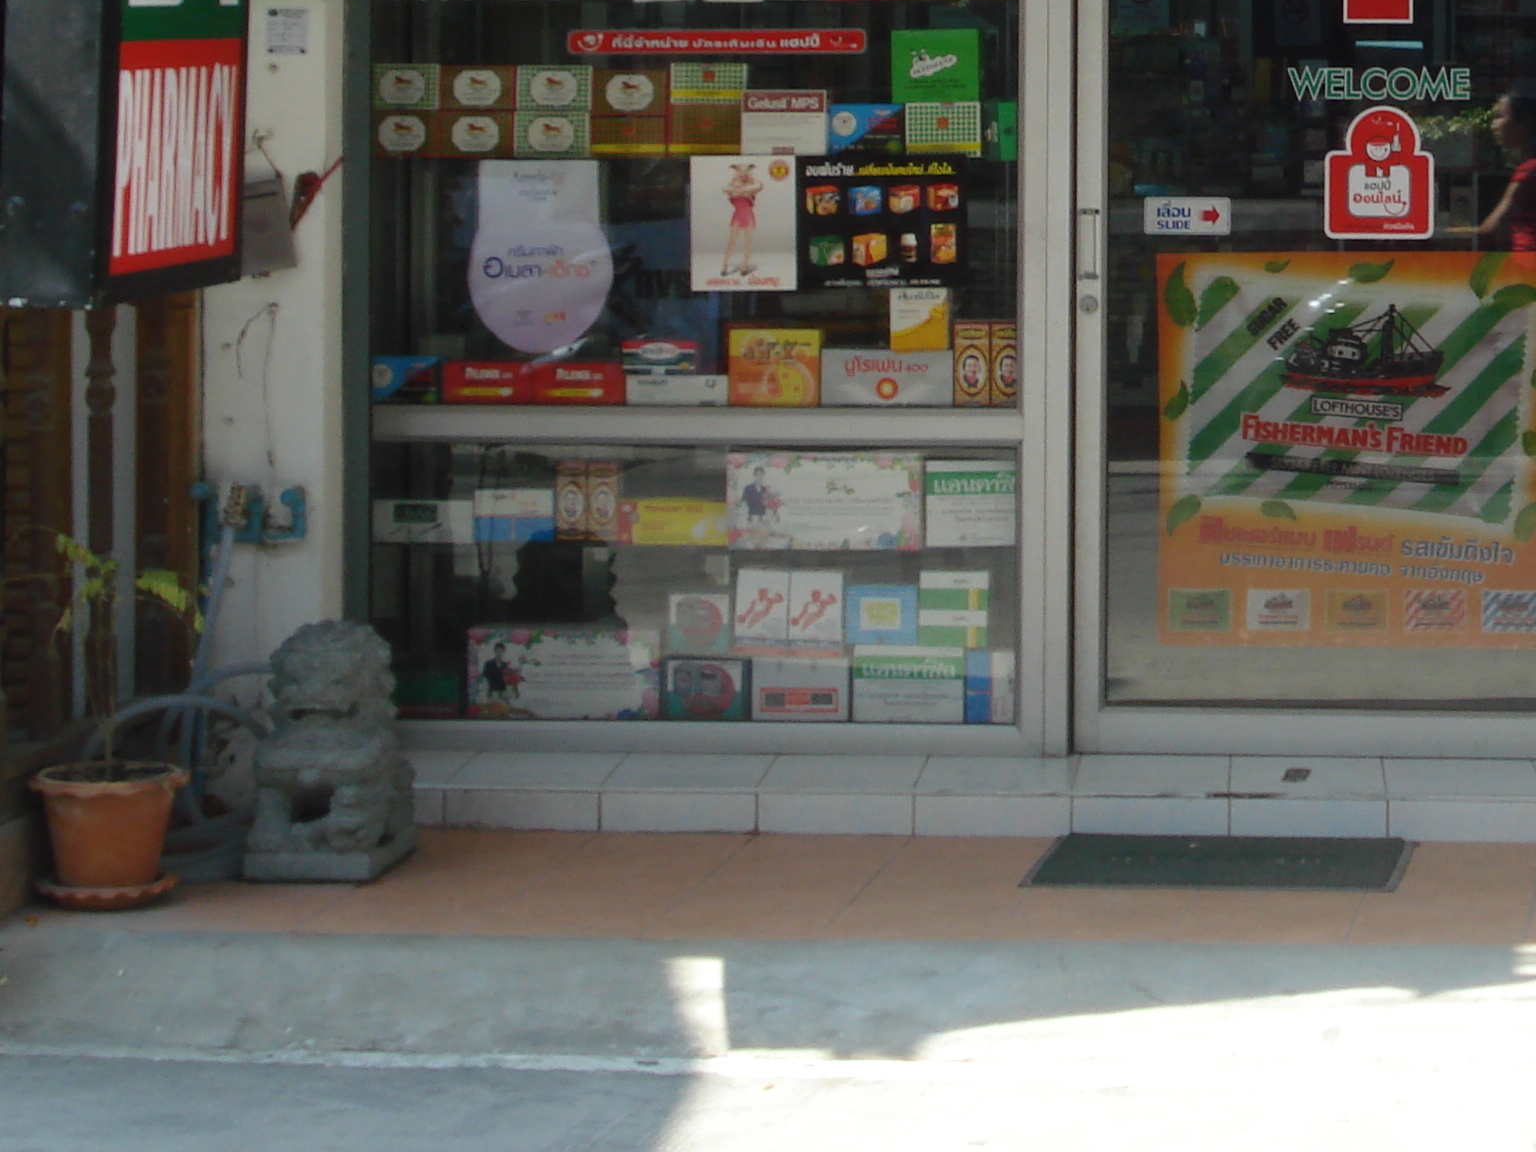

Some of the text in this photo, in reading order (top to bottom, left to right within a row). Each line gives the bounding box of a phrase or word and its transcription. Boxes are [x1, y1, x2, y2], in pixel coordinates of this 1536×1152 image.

[1287, 65, 1471, 102] WELCOME
[112, 62, 239, 258] PHARMACY
[1156, 199, 1192, 218] เลื่อน
[1156, 219, 1191, 230] SLIDE
[1245, 296, 1289, 338] SUGAR
[1266, 317, 1302, 352] FREE
[1312, 399, 1401, 418] LOFTHOUSE'S
[1241, 414, 1469, 458] FISHERMAN'S FRIEND
